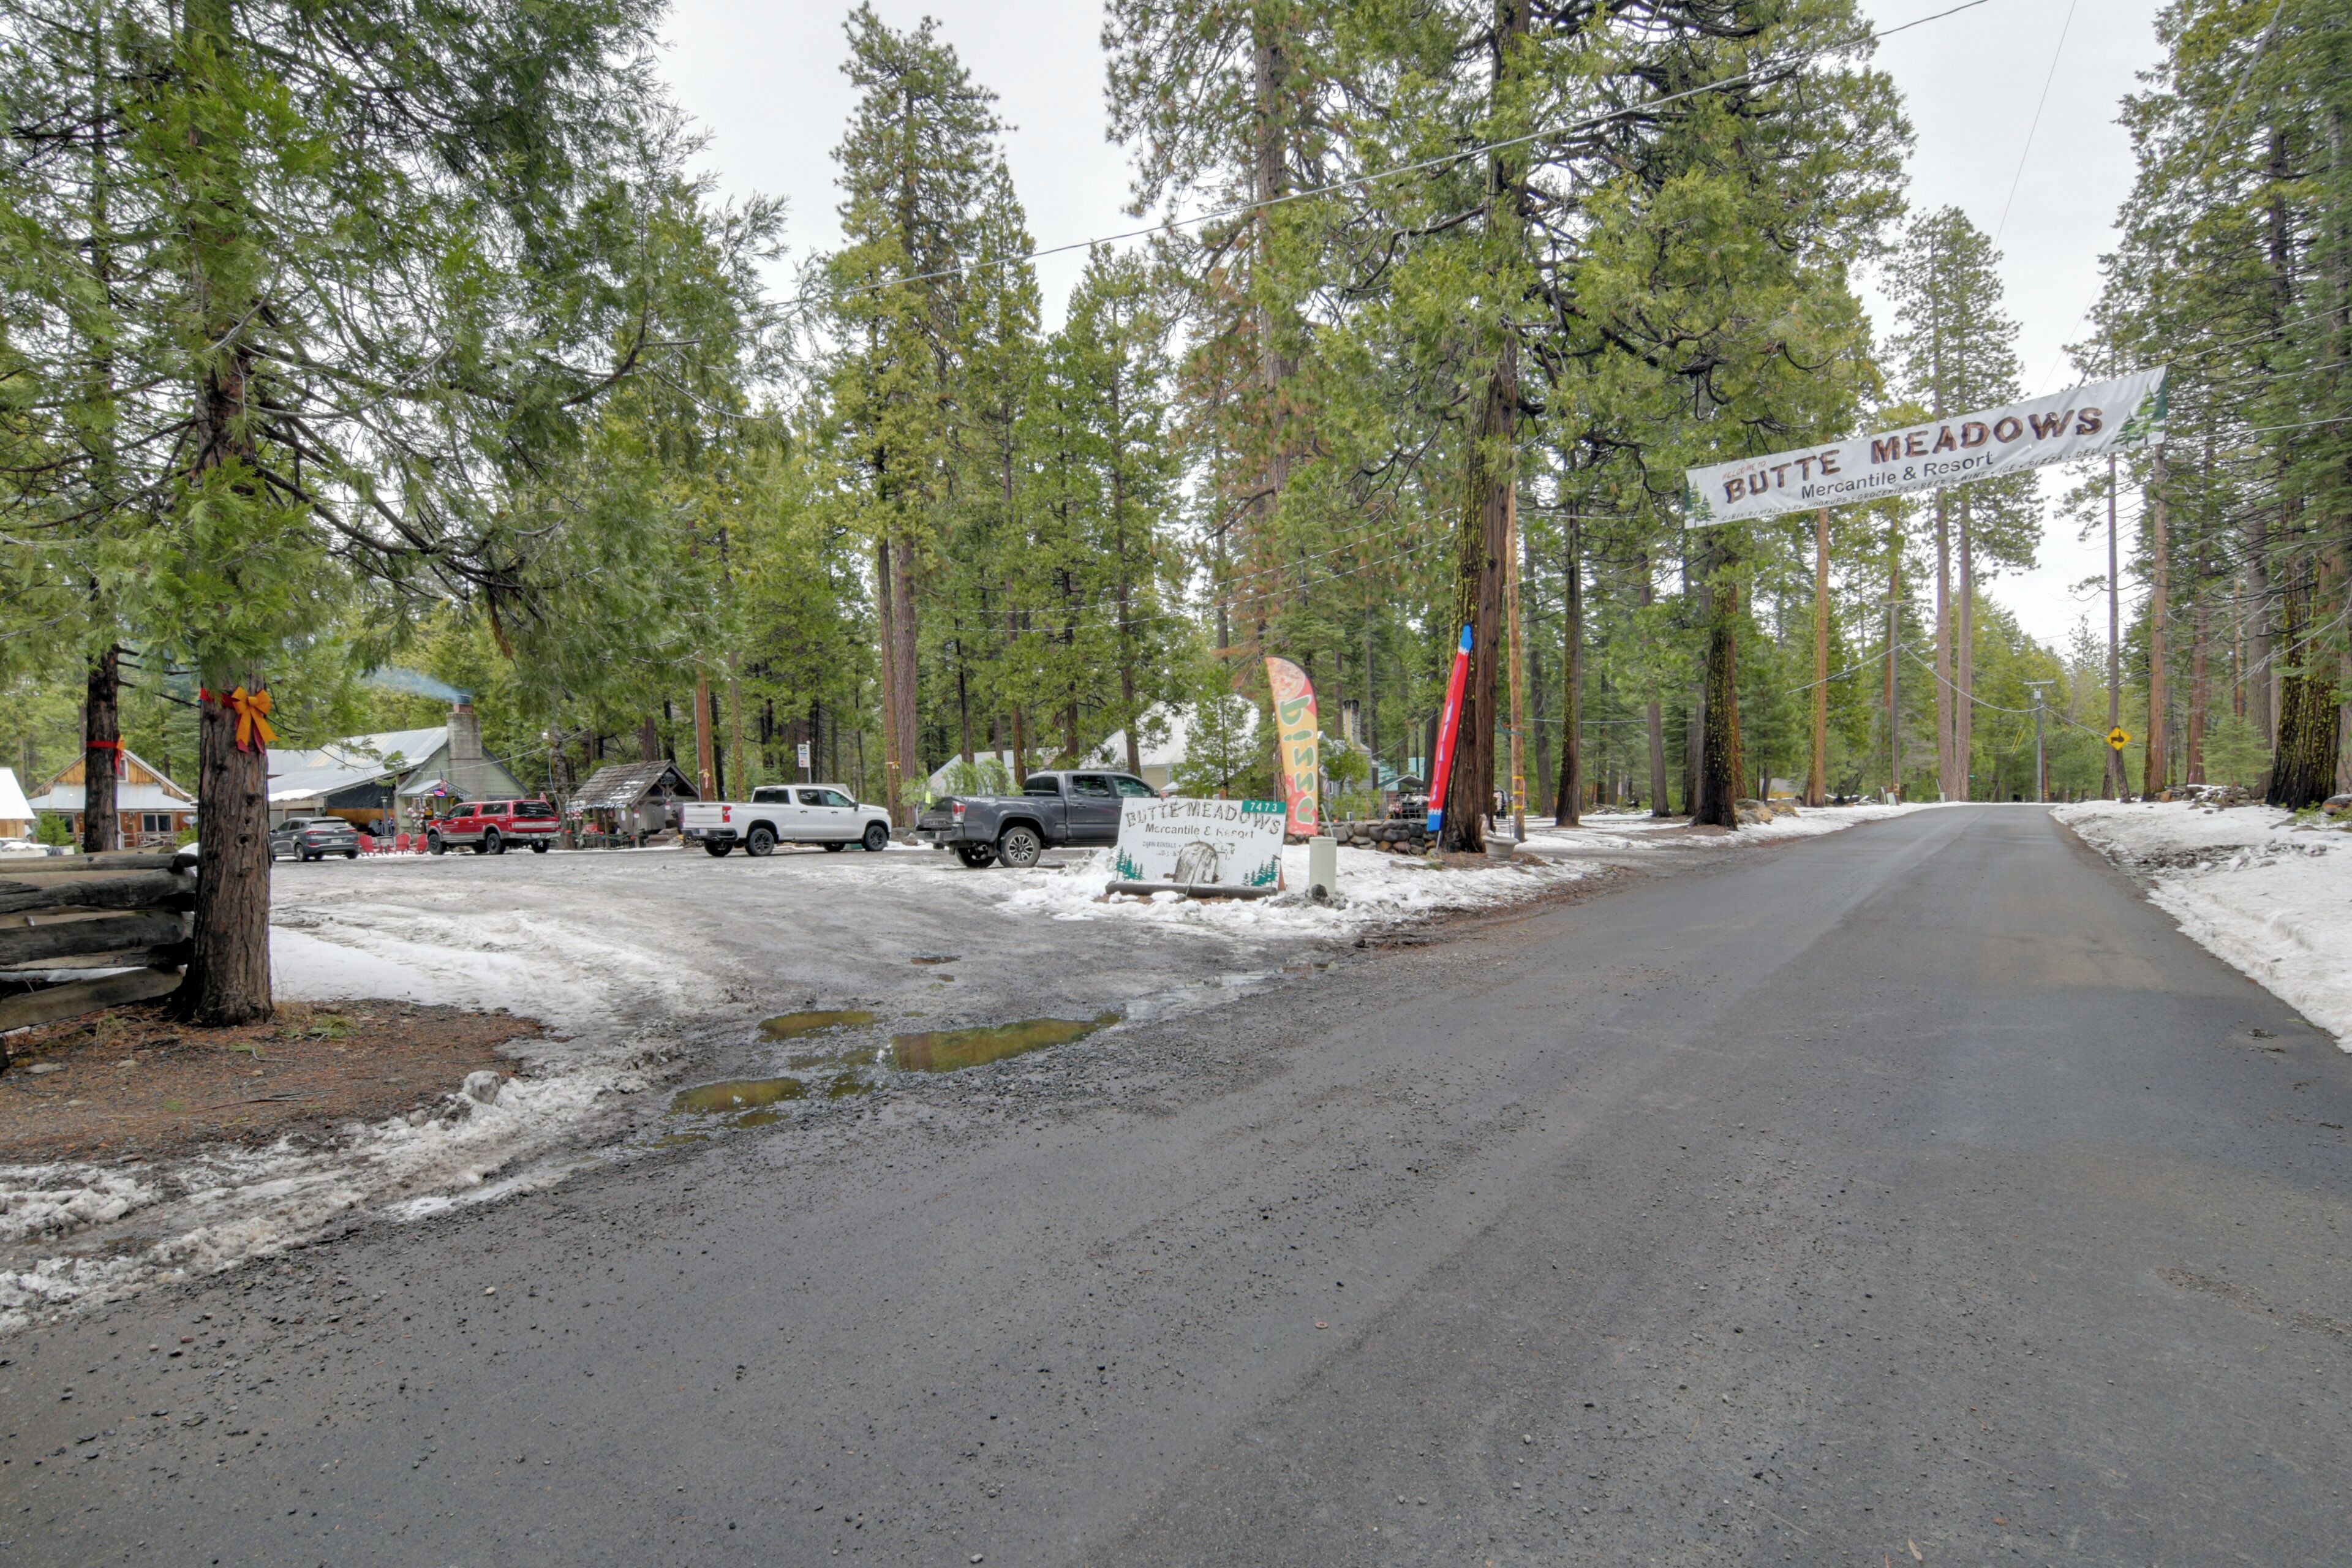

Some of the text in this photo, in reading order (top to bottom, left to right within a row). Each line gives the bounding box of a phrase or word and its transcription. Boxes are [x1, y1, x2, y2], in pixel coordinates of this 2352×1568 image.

[1722, 407, 2103, 504] BUTTE MEADOWS
[1722, 461, 1766, 480] WELCOME TO
[1747, 507, 1783, 517] RENTALS
[1807, 496, 1847, 508] HOOKUPS
[1857, 486, 1909, 500] GROCERIES
[1920, 479, 1946, 489] BEER
[1961, 470, 1987, 481] WINE
[1998, 464, 2016, 474] ICE
[2028, 454, 2062, 467] PIZZA
[2075, 446, 2103, 458] DELI
[1802, 451, 1993, 499] Mercantile & Resort
[1125, 801, 1281, 835] BUTTE MEADOWS
[1250, 802, 1278, 812] 7473
[1145, 823, 1200, 835] Mercantile
